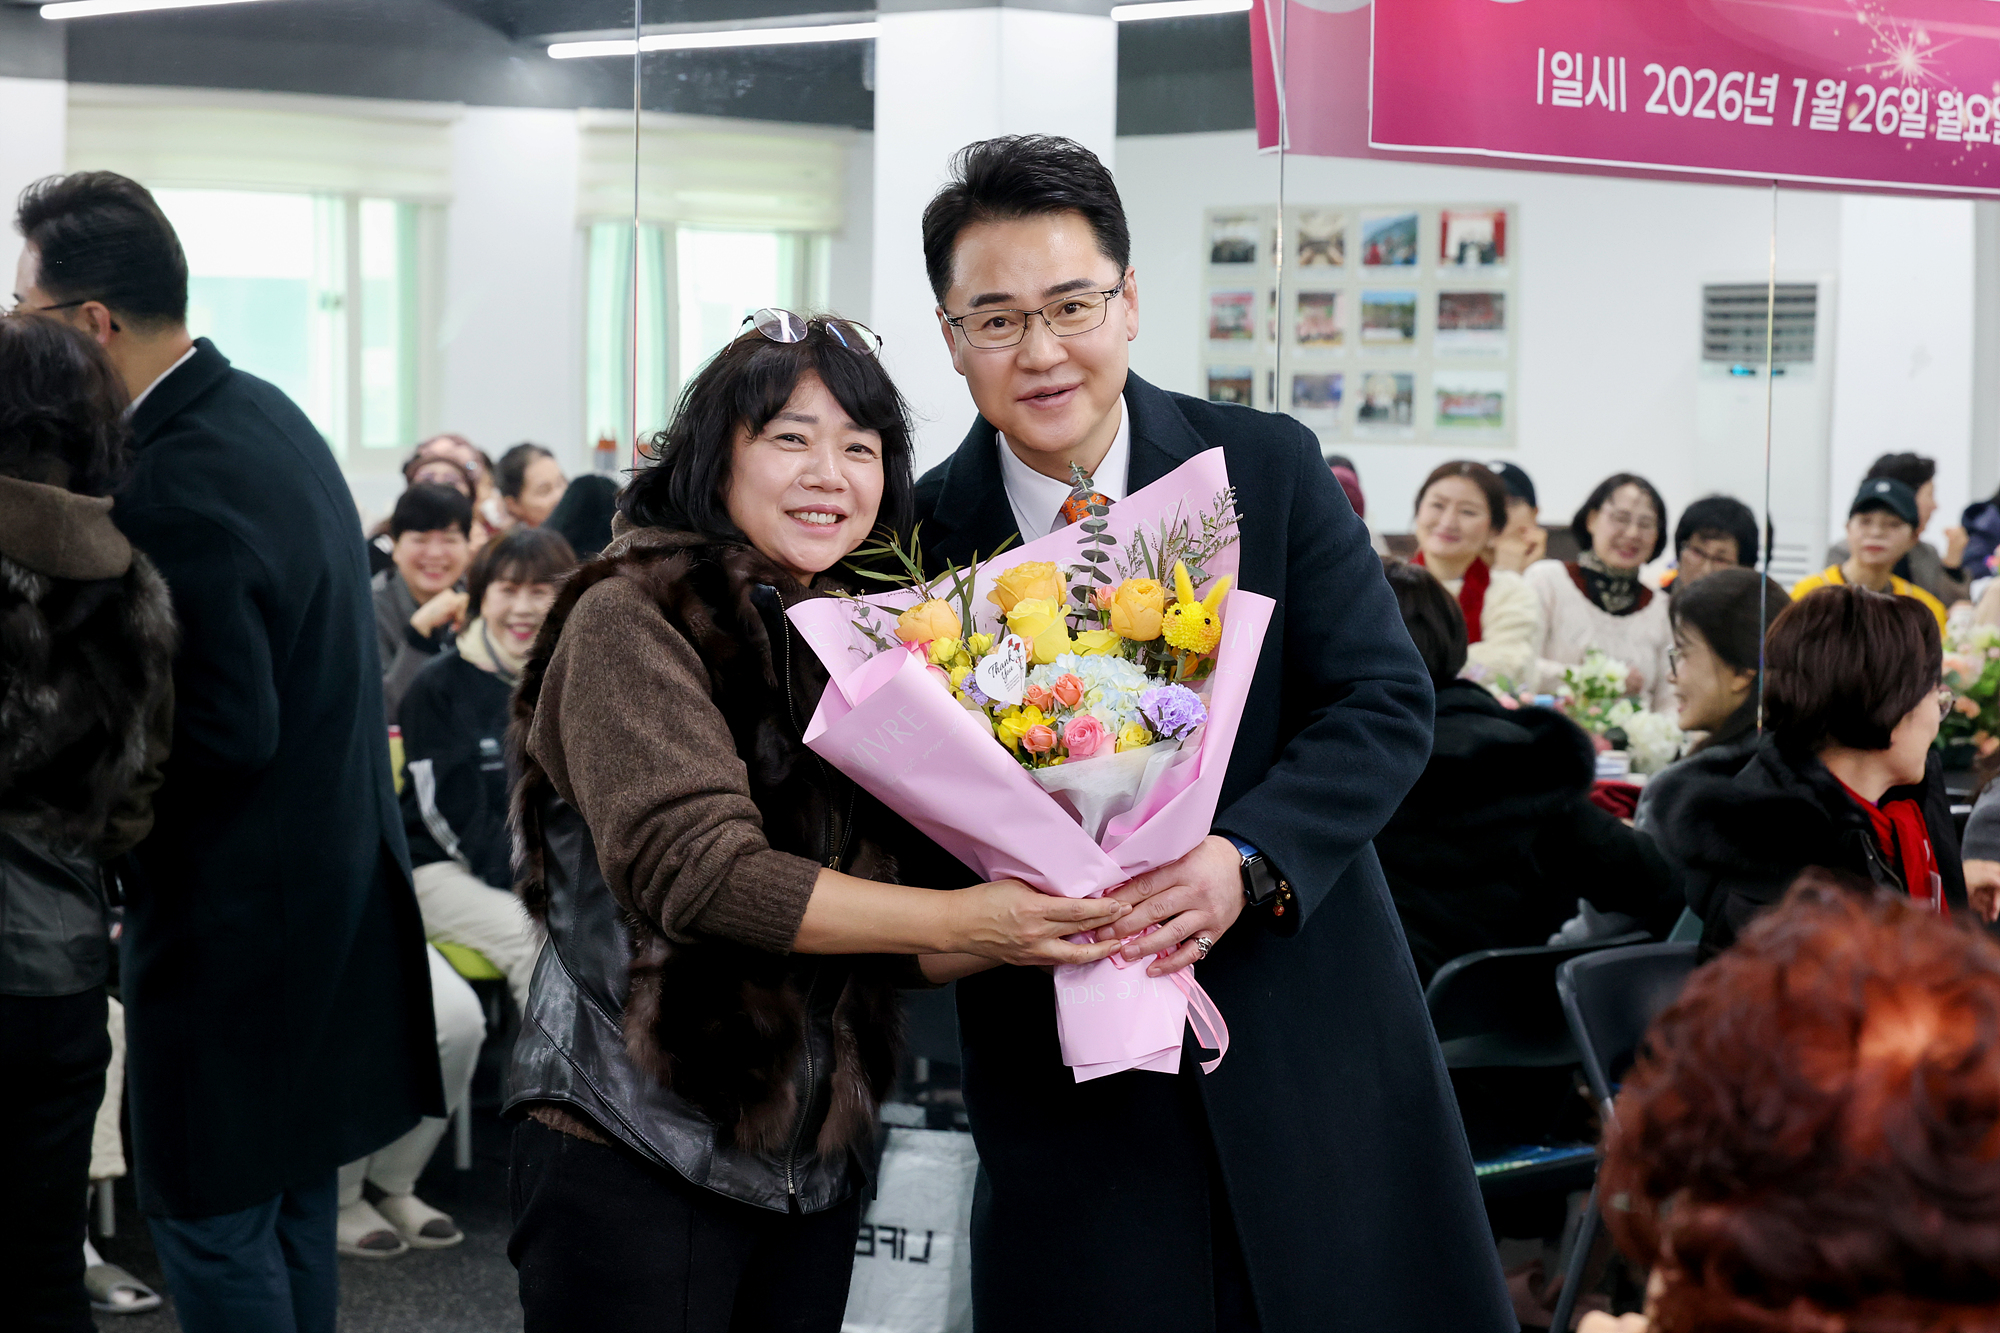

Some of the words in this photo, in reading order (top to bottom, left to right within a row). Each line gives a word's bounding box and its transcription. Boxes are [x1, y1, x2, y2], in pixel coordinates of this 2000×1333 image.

[1643, 63, 1779, 126] 2026년
[1792, 78, 1847, 132] 1월
[1848, 84, 1928, 139] 26일
[988, 649, 1014, 678] Thank
[841, 705, 927, 770] VIVRE
